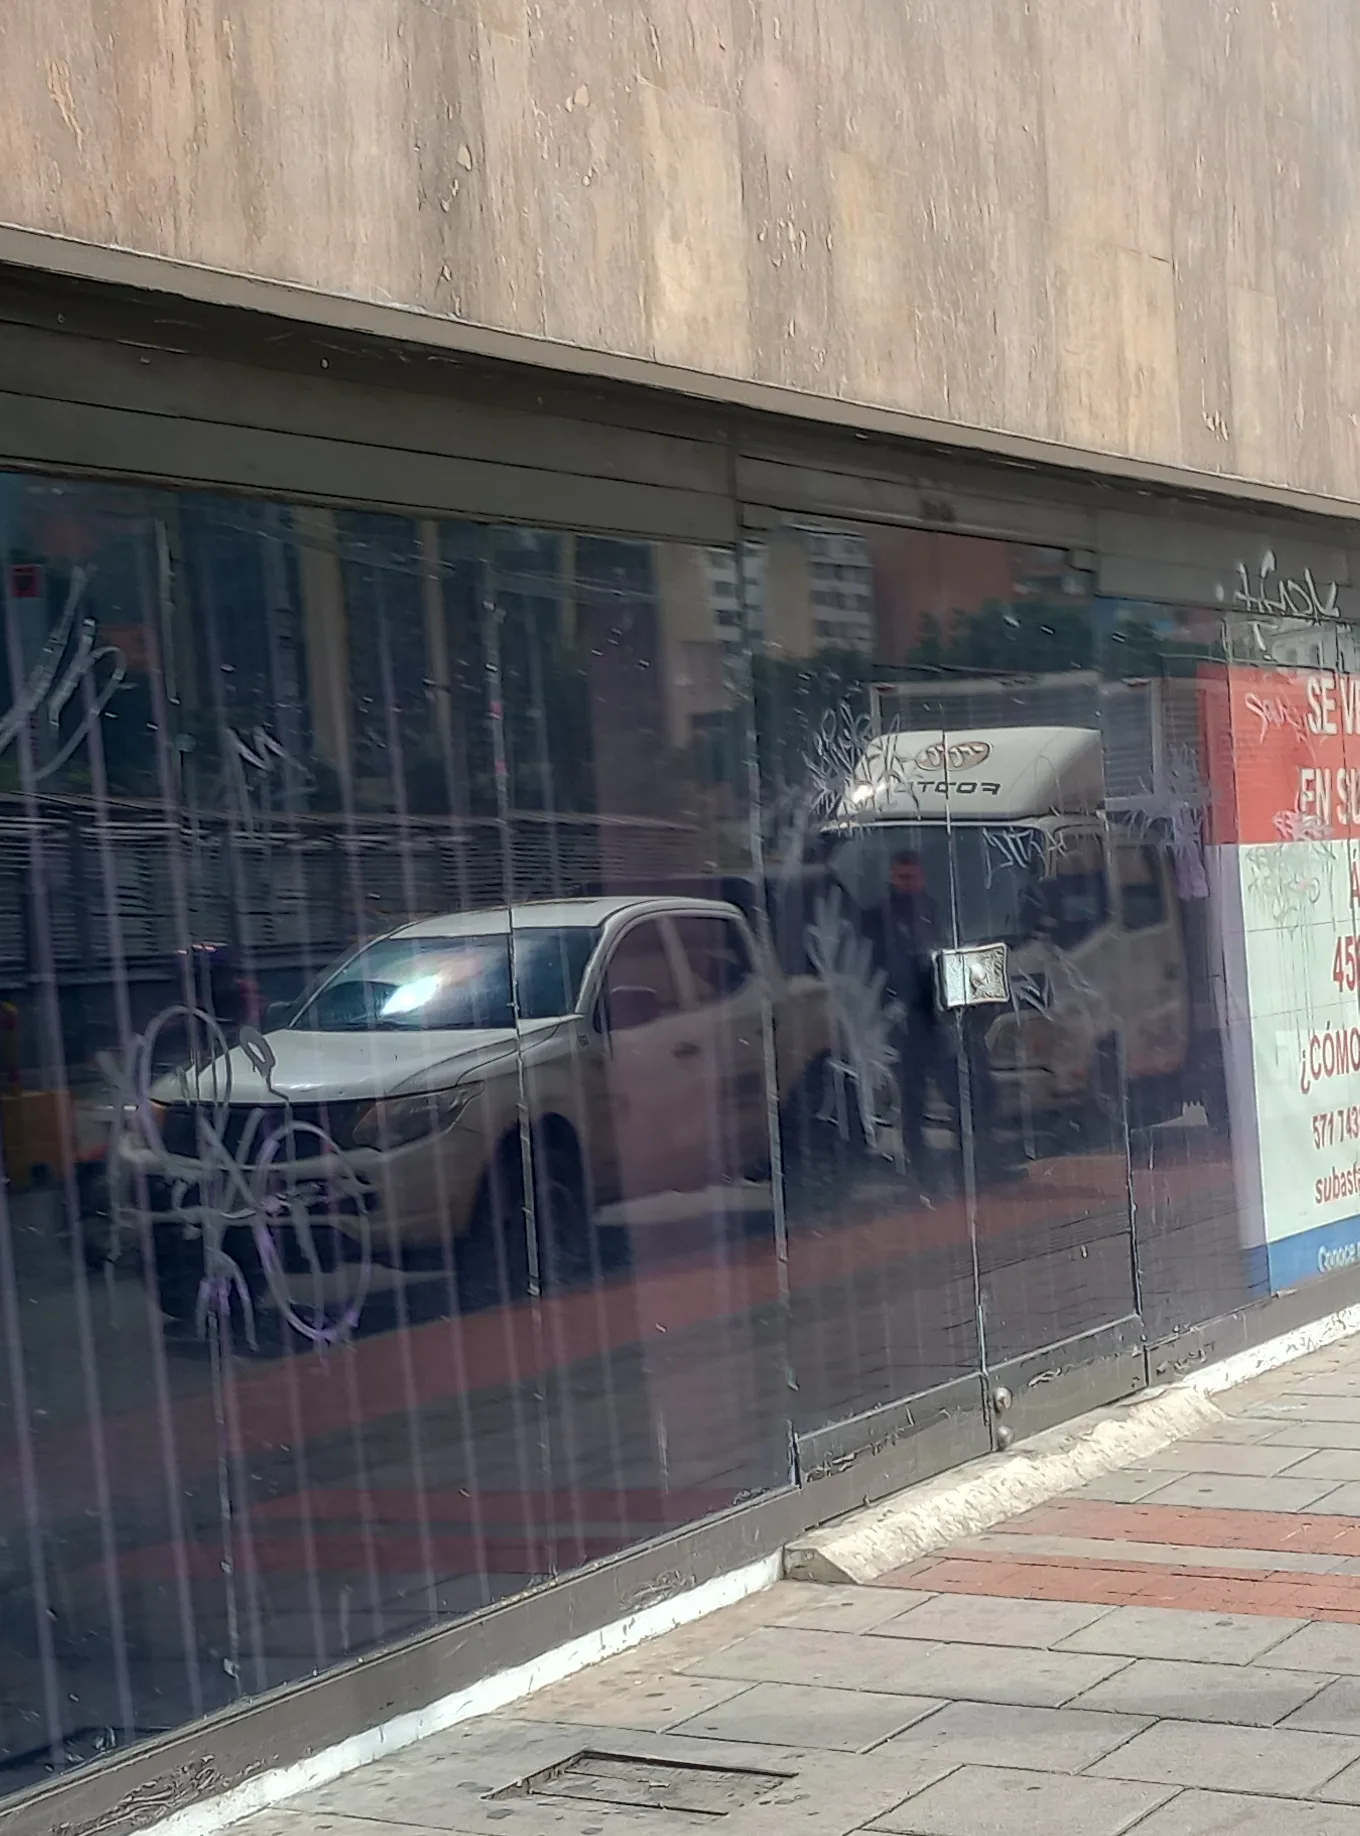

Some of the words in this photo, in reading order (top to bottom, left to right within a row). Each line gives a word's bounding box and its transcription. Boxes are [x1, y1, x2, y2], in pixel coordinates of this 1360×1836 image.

[1306, 676, 1338, 735] SE
[1300, 768, 1332, 825] EN
[1312, 1111, 1334, 1150] 571
